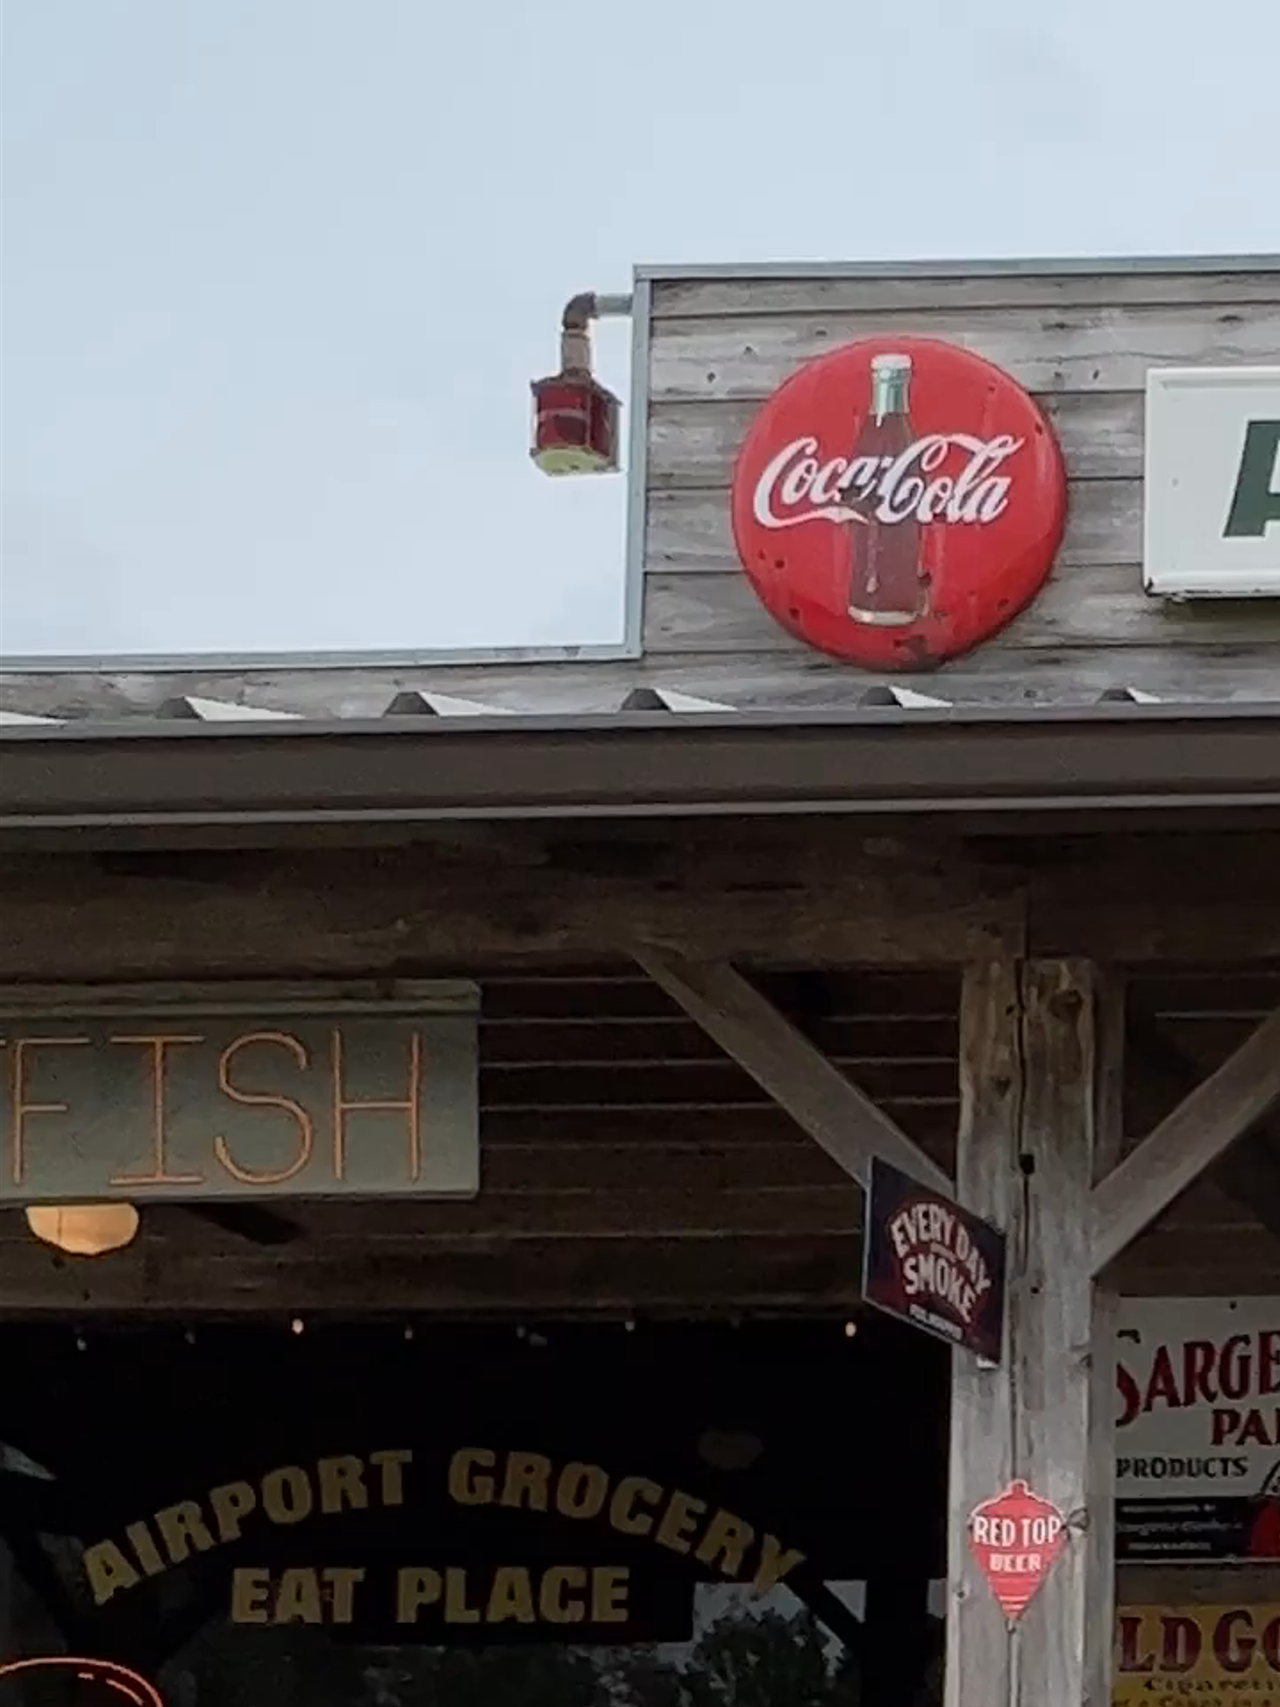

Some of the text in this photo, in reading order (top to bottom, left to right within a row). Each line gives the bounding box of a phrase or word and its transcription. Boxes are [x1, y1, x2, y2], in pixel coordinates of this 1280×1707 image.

[753, 432, 1025, 528] Coca-Cola
[0, 1030, 423, 1185] FISH
[890, 1202, 993, 1296] EVERY DAY
[902, 1254, 977, 1324] SMOKE
[1116, 1456, 1249, 1478] PRODUCTS
[83, 1448, 805, 1606] AIRPORT GROCERY
[973, 1514, 1063, 1548] RED TOP
[989, 1553, 1042, 1572] BEER
[231, 1566, 630, 1625] EAT PLACE
[1118, 1615, 1202, 1672] LD
